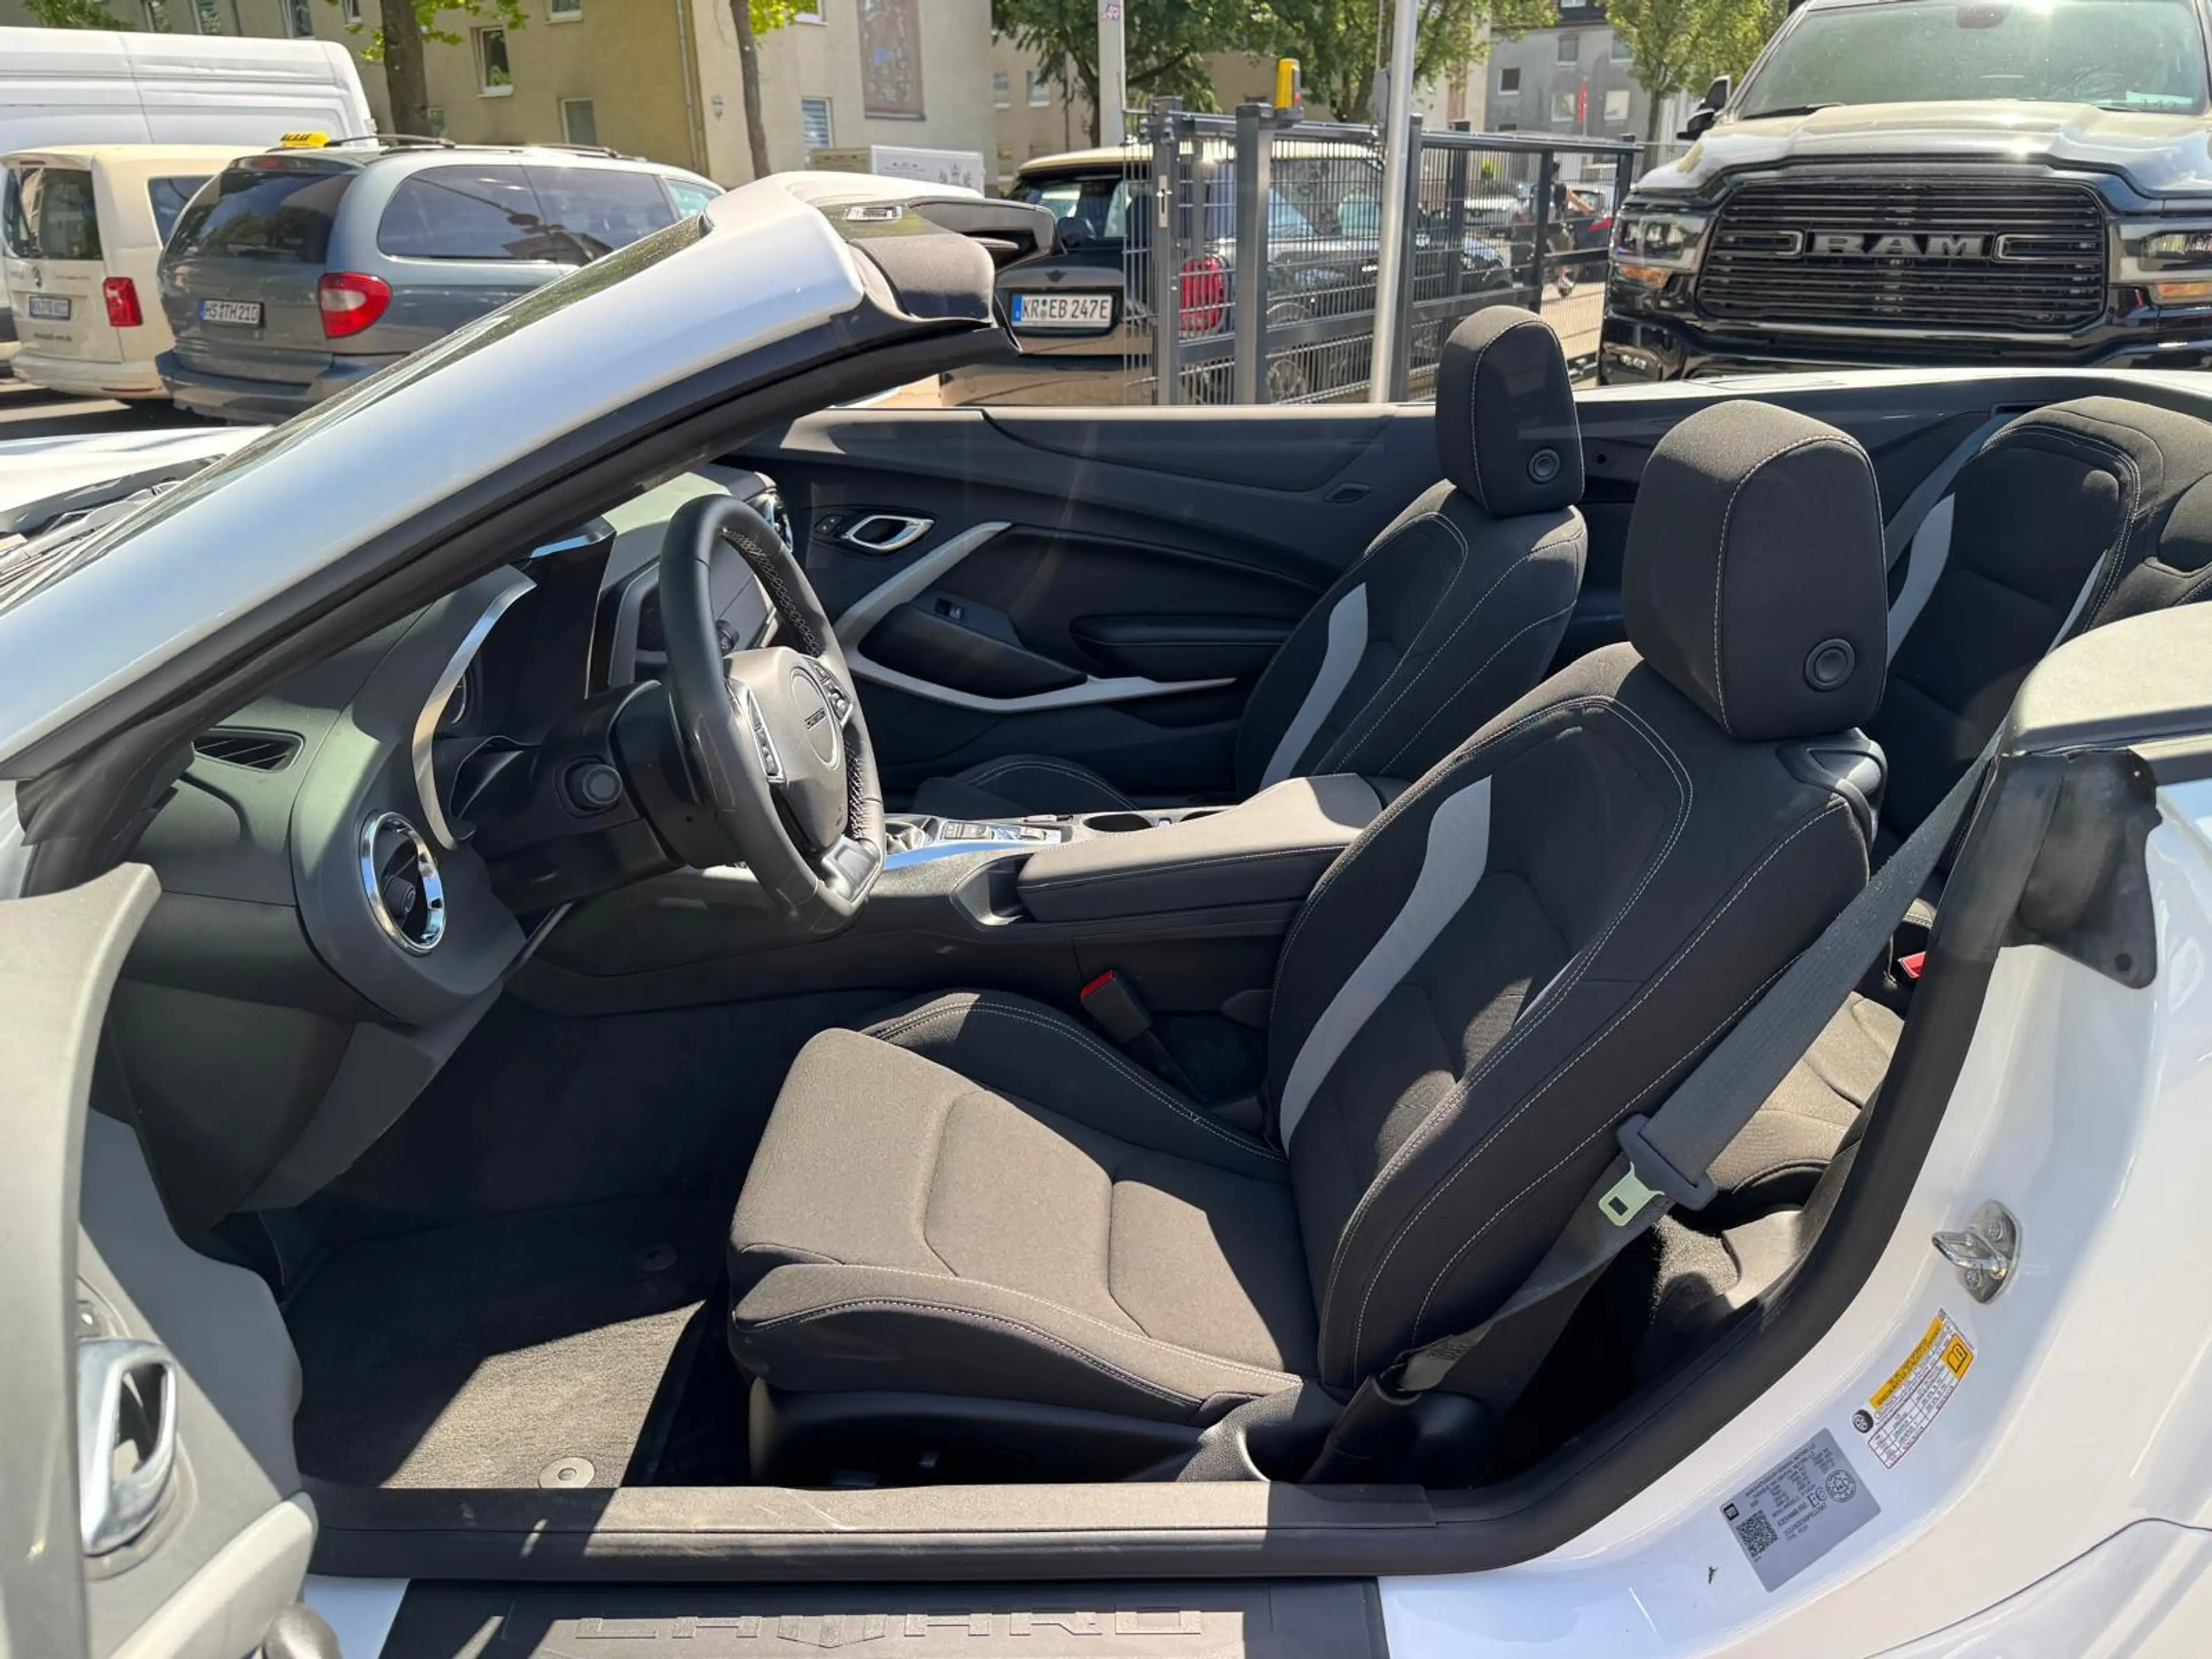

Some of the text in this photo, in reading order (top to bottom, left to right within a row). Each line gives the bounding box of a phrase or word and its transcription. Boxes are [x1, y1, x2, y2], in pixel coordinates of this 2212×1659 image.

[1815, 234, 1983, 254] RAM
[1023, 299, 1108, 319] KR EB 247E
